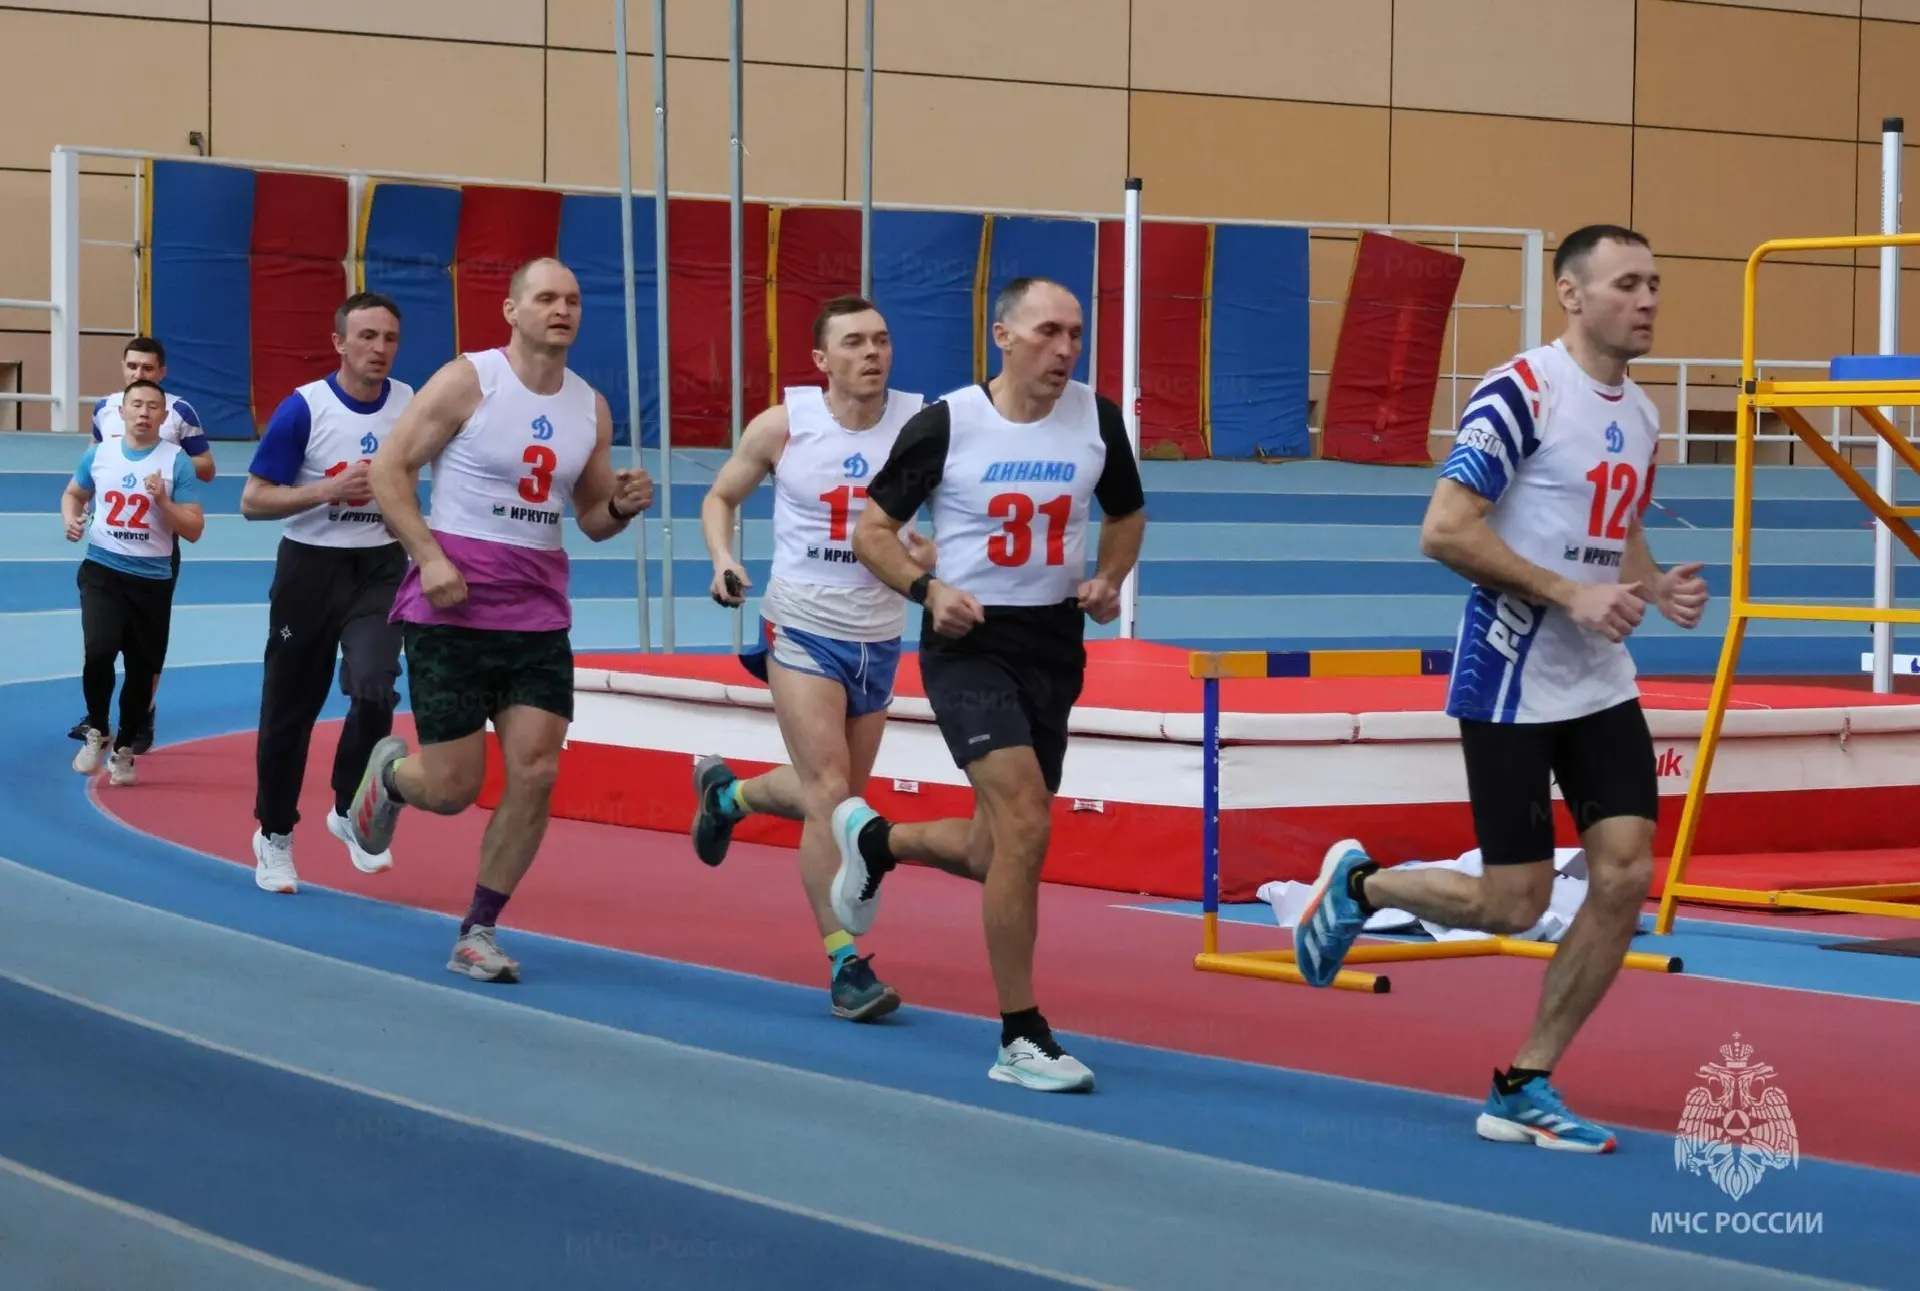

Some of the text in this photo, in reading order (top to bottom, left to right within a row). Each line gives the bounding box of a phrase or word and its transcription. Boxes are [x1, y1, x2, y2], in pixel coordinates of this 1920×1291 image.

[518, 445, 557, 503] 3
[981, 462, 1076, 482] ДИНАМО
[1586, 461, 1638, 540] 12
[105, 491, 151, 529] 22
[987, 492, 1072, 568] 31
